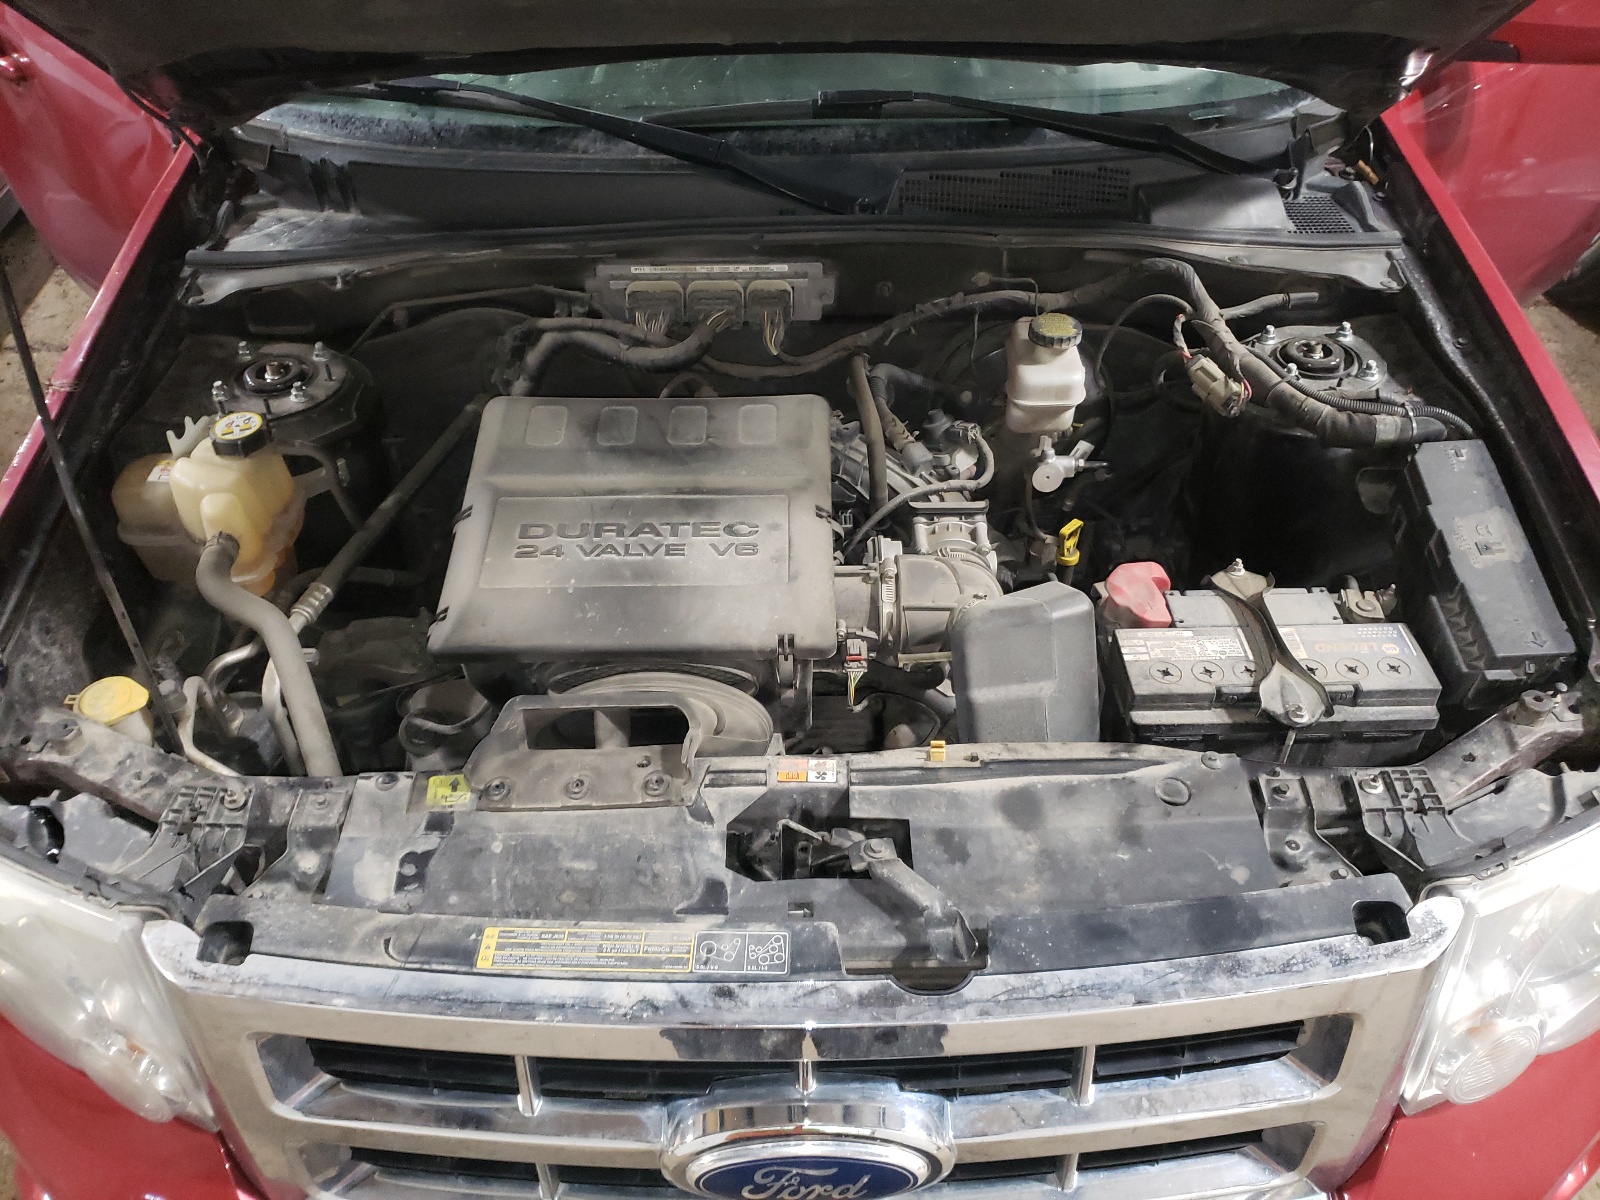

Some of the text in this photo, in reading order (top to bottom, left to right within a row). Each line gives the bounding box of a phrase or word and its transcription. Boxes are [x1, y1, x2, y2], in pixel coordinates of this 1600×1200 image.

[518, 521, 760, 540] DURATEC
[514, 542, 760, 559] 24 VALVE V6
[1315, 642, 1378, 653] LEGEND
[741, 1166, 871, 1200] Ford
